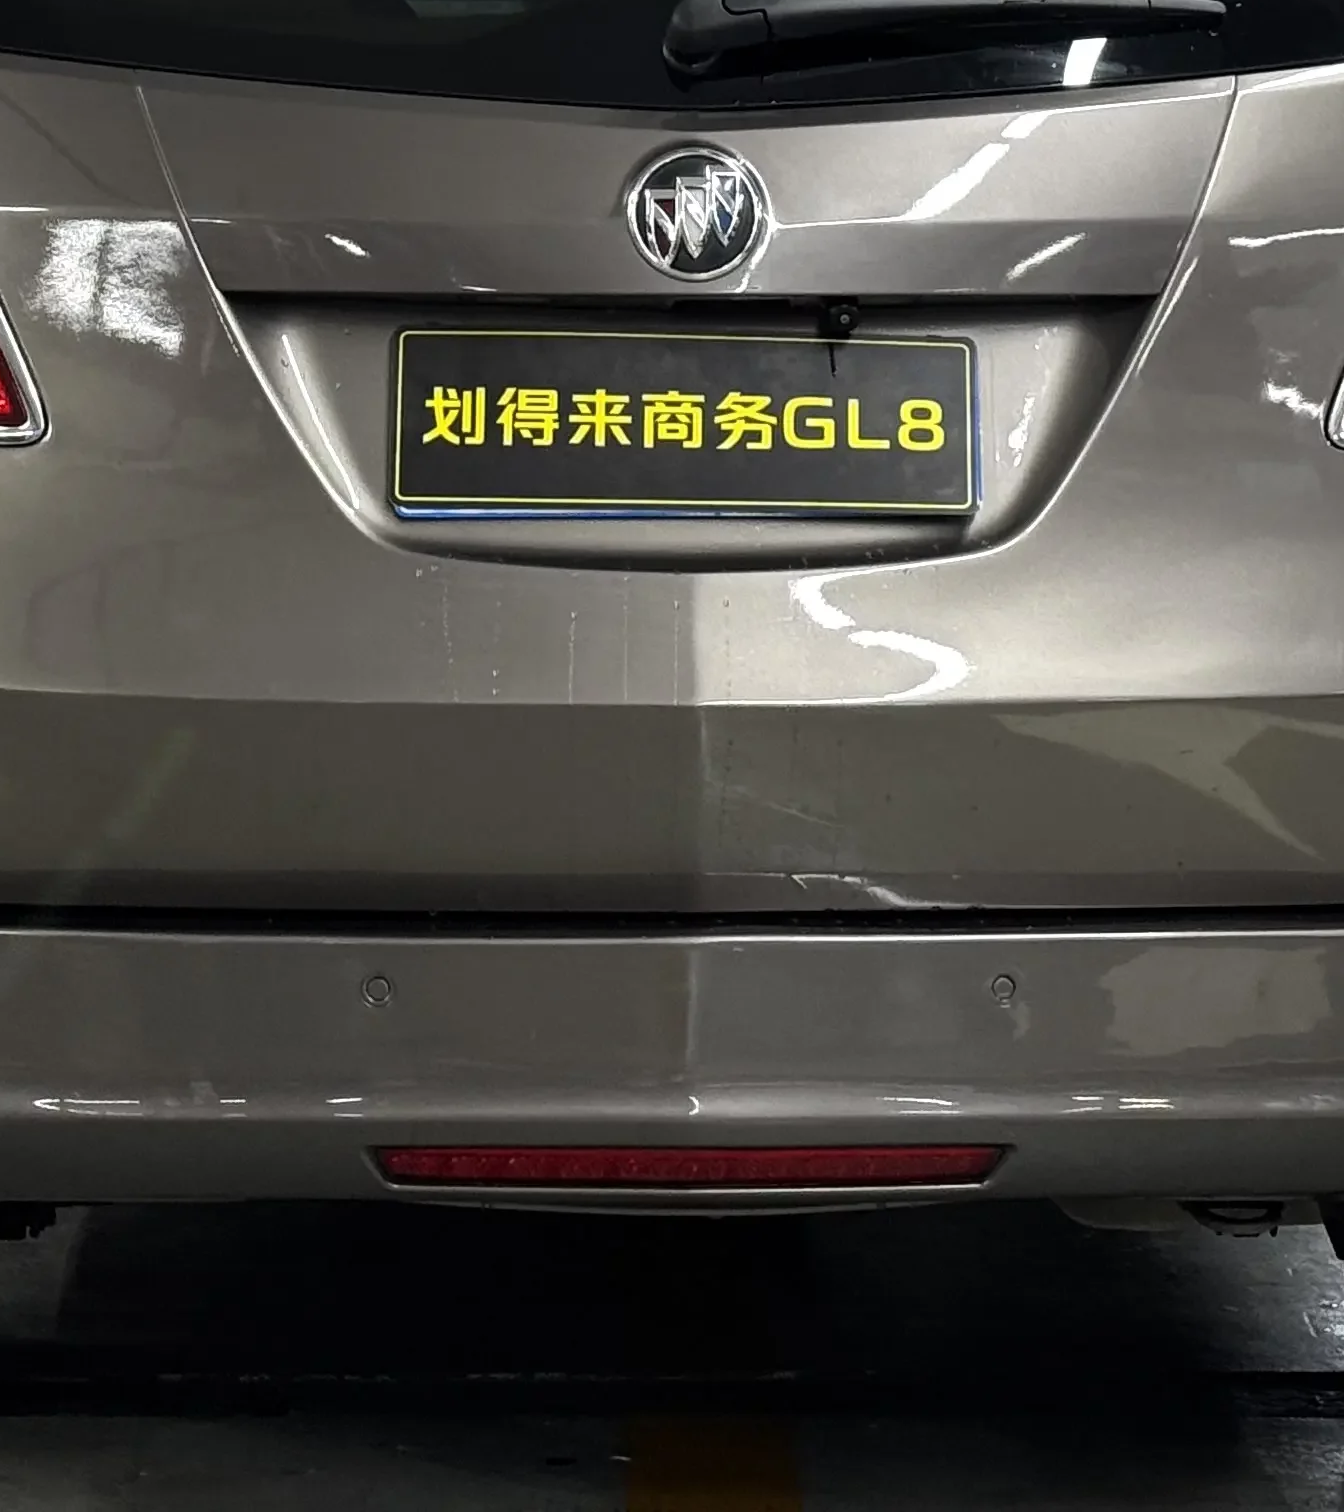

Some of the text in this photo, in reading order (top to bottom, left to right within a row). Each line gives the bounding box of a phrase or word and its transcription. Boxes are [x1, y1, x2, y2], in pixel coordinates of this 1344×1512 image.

[422, 385, 946, 453] 划得来商务GL8
